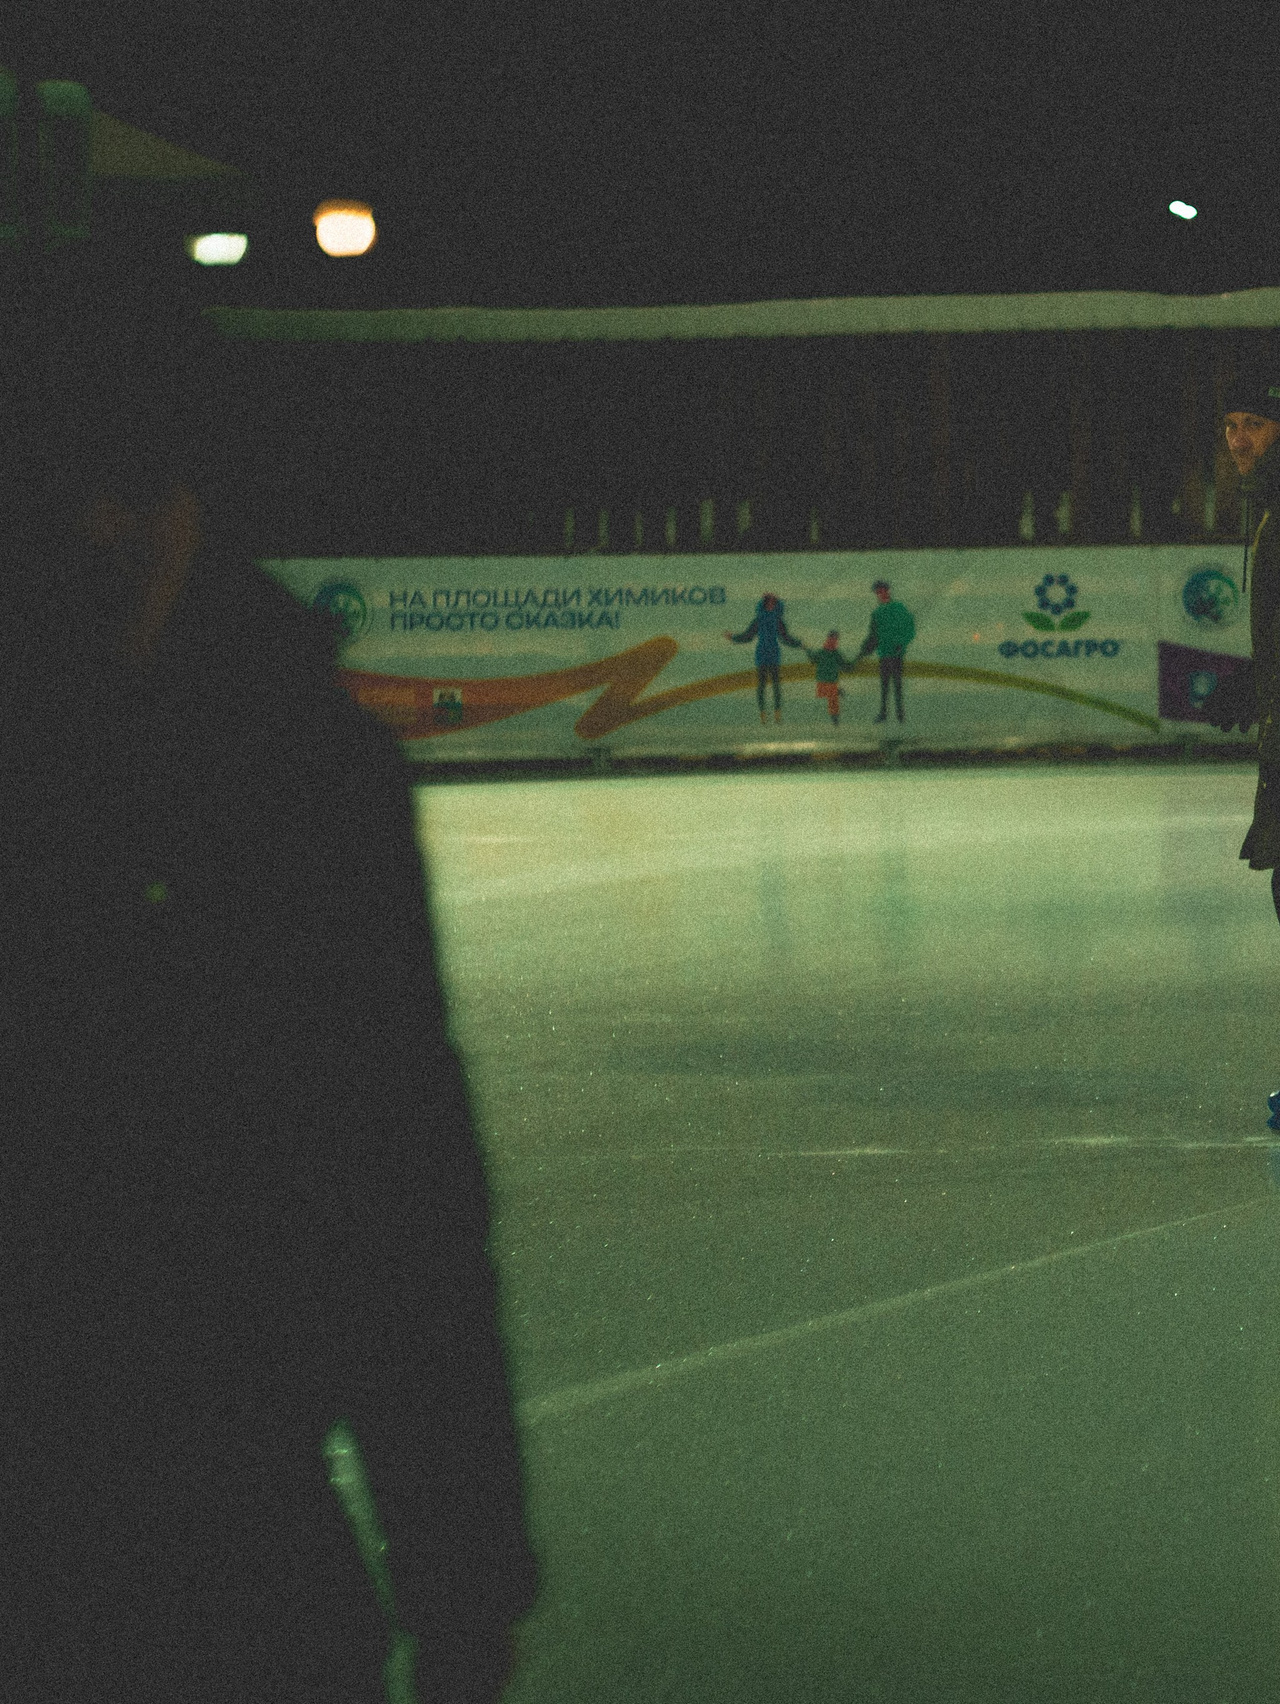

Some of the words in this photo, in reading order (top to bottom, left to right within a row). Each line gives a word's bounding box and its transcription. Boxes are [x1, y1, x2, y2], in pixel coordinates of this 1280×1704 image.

[389, 590, 426, 608] НА
[432, 588, 581, 609] ПЛОЩАДИ
[588, 585, 726, 607] ХИМИКОВ
[390, 610, 499, 631] ПРОСТО
[506, 610, 620, 631] СКАЗКА!
[999, 638, 1121, 658] ФОСАГРО
